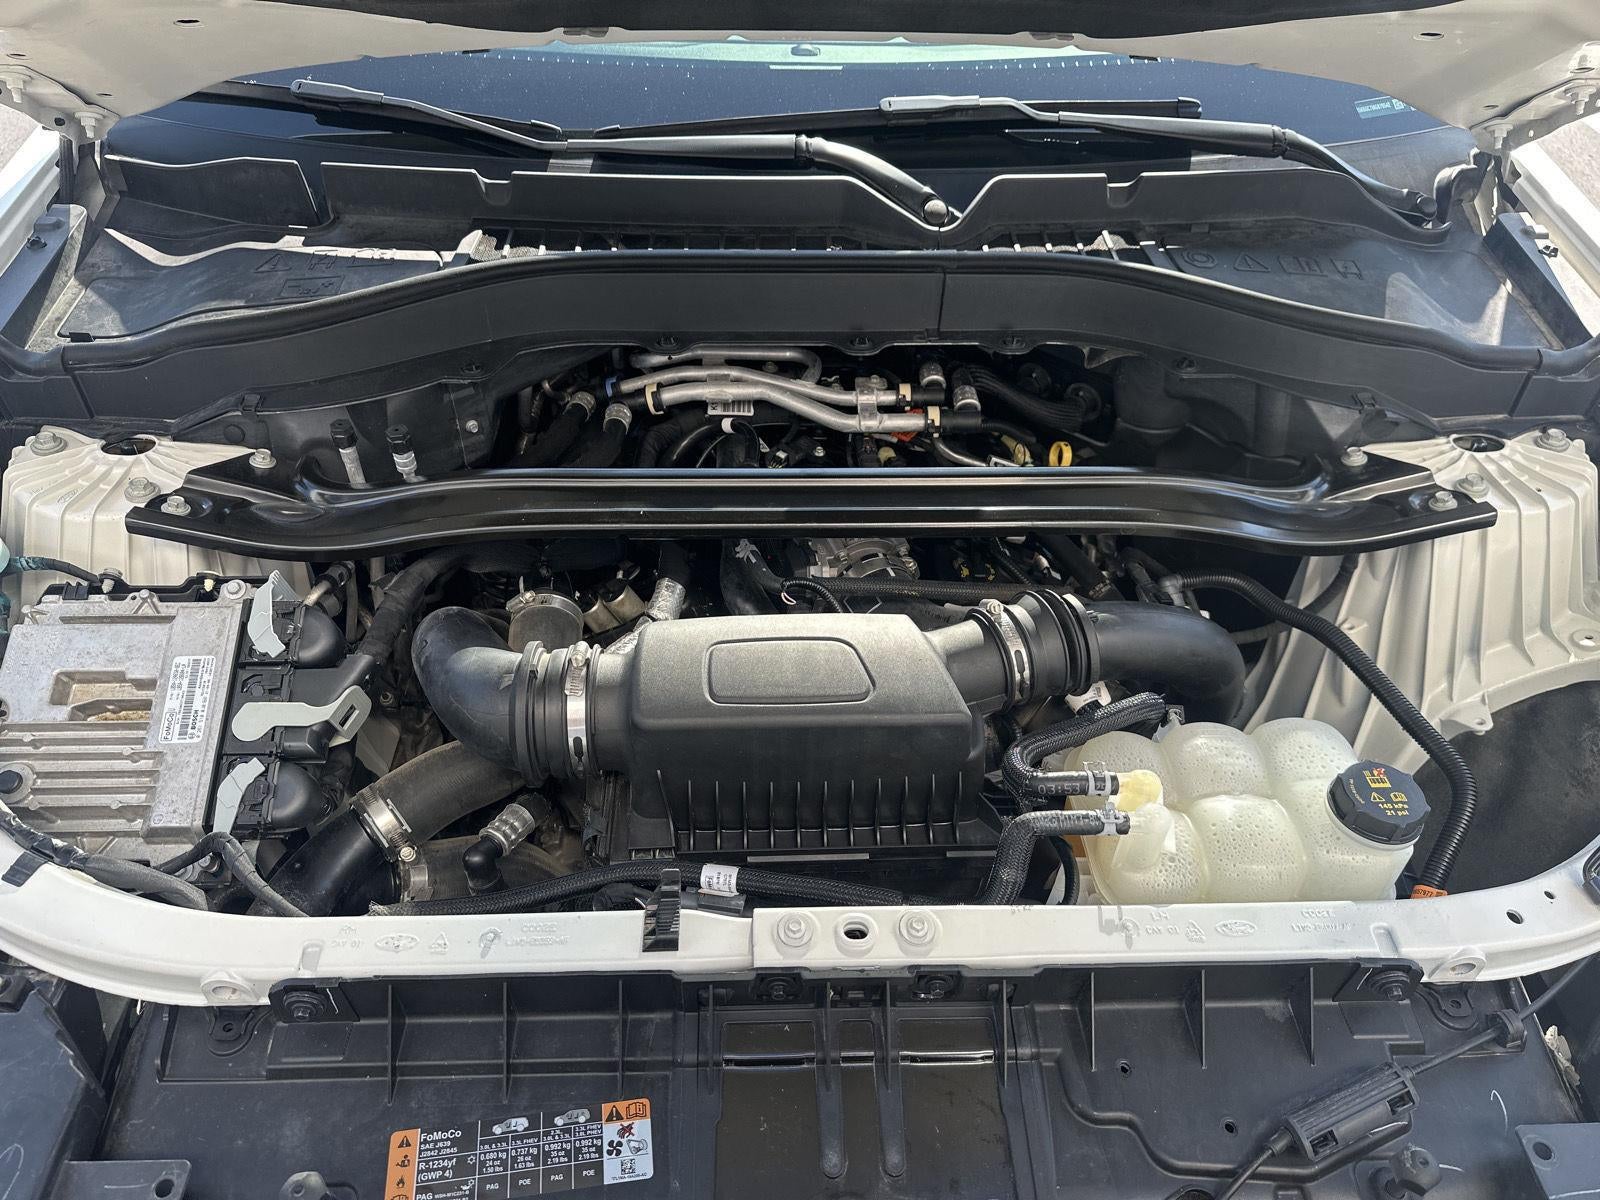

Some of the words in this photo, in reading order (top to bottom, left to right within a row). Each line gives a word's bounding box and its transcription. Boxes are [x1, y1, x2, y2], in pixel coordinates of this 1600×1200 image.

[190, 709, 199, 730] BOSCH
[163, 713, 175, 740] FoMoCo
[1038, 783, 1080, 794] 03:53
[421, 1129, 462, 1142] FoMoCo
[544, 1143, 561, 1151] 0.992
[562, 1142, 571, 1150] kg
[575, 1139, 592, 1147] 0.992
[593, 1138, 601, 1147] kg
[439, 1147, 458, 1155] J2845
[480, 1152, 497, 1160] 0.680
[499, 1151, 507, 1159] kg
[511, 1148, 528, 1156] 0.737
[529, 1147, 537, 1155] kg
[419, 1158, 457, 1170] R-1234yf
[418, 1171, 443, 1182] (GWP
[443, 1170, 453, 1179] 4)
[518, 1178, 531, 1186] POE
